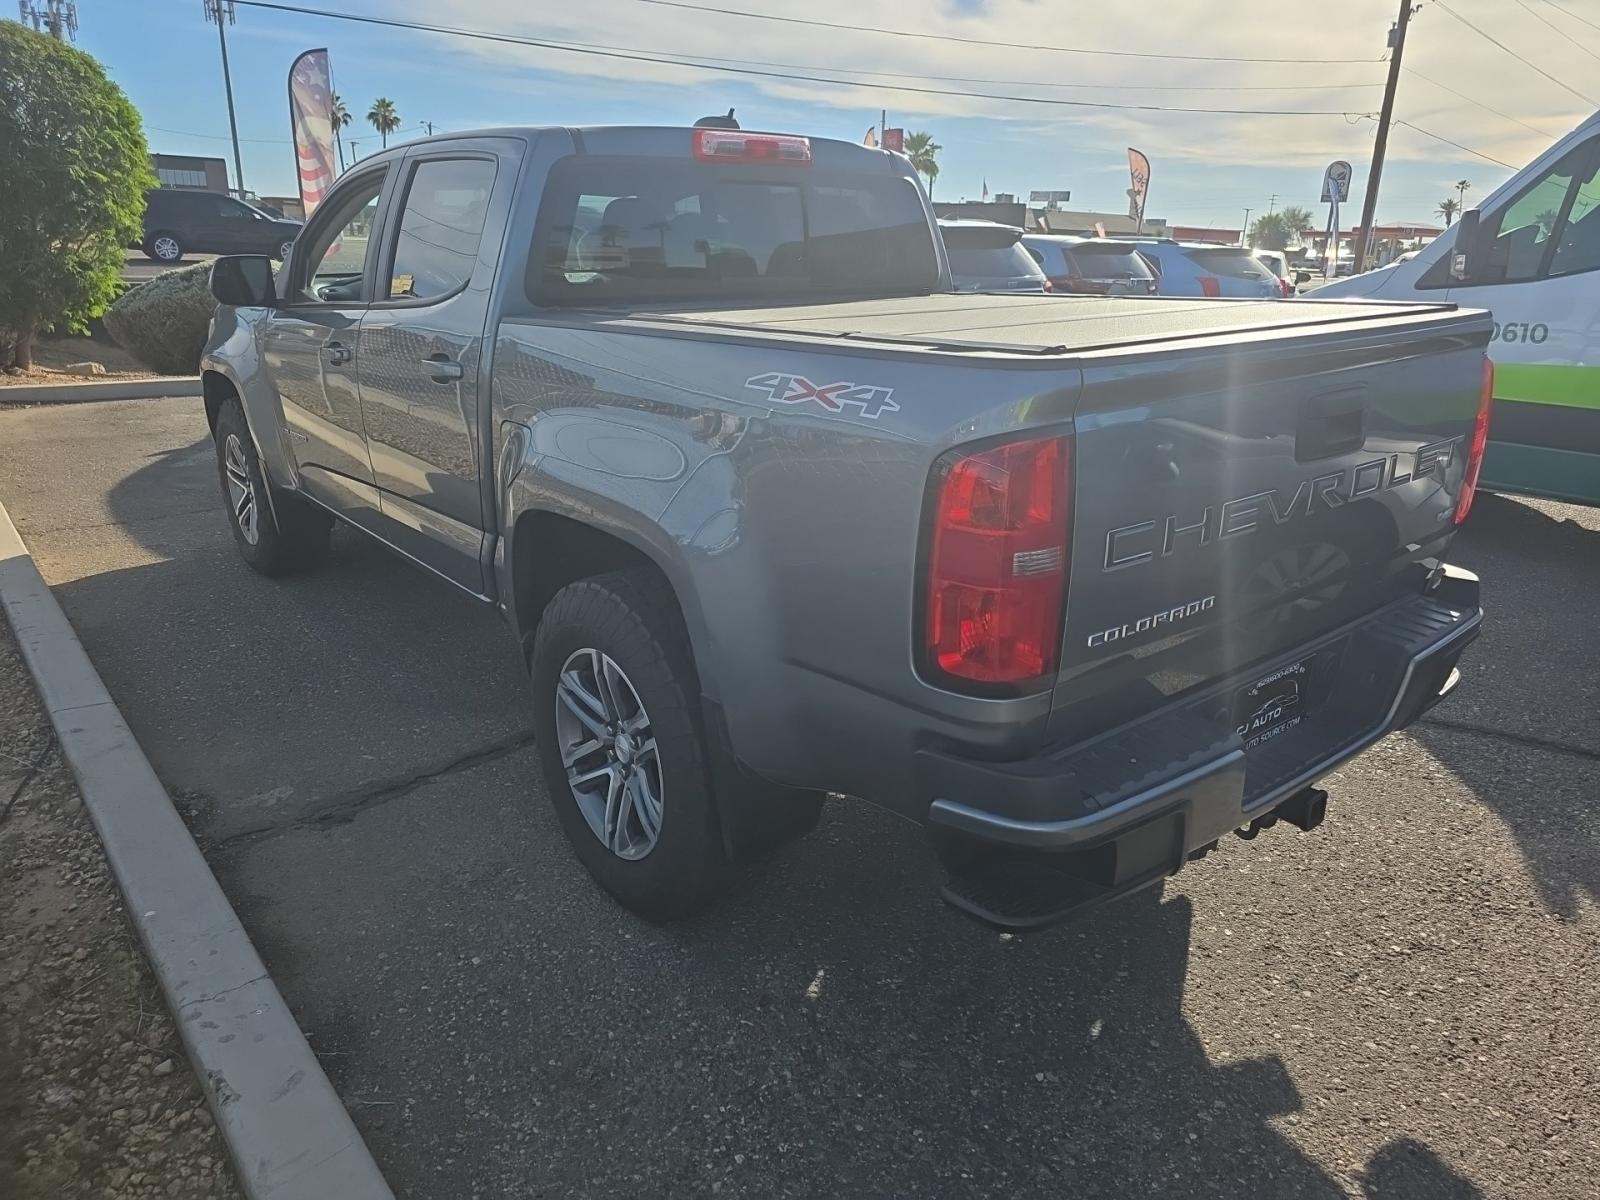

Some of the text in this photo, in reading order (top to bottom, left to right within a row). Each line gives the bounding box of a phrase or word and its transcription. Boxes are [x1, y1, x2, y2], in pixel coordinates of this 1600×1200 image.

[1103, 434, 1465, 572] CHEVROLET
[1087, 595, 1216, 648] COLORADO
[1251, 707, 1282, 729] AUTO
